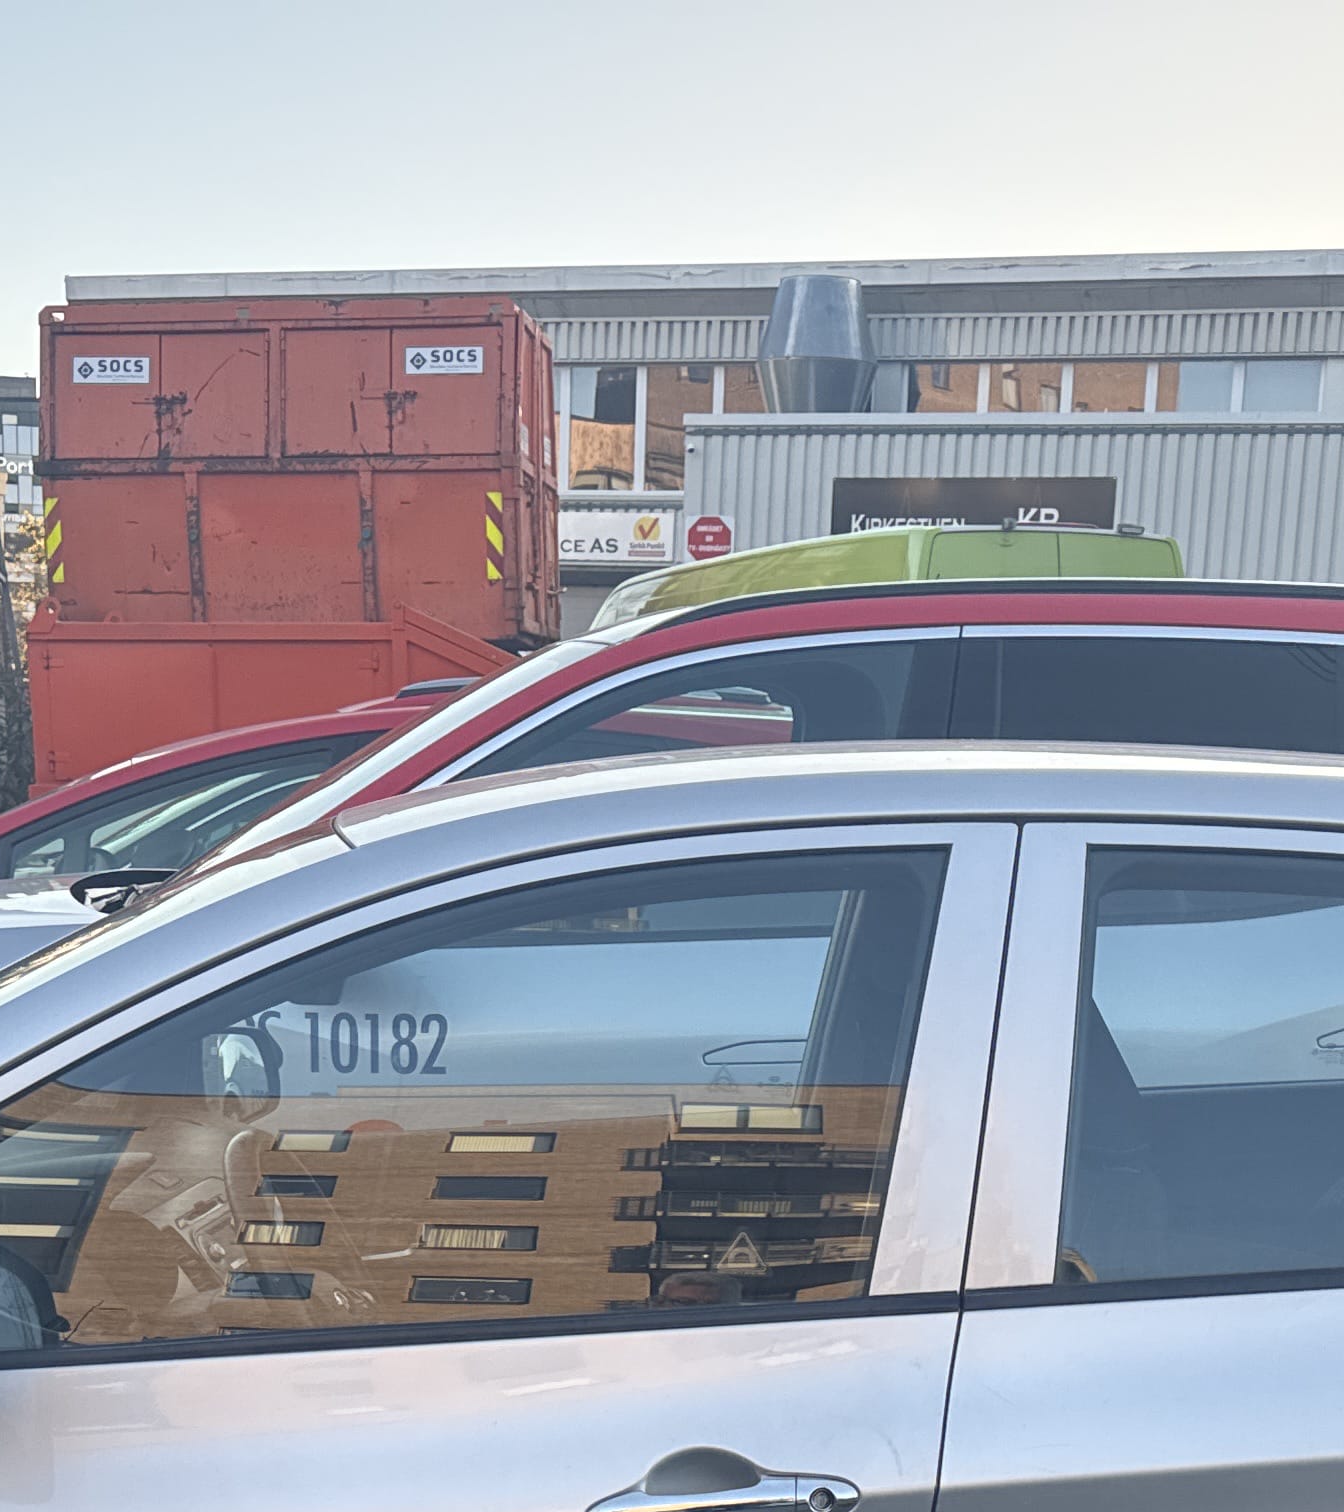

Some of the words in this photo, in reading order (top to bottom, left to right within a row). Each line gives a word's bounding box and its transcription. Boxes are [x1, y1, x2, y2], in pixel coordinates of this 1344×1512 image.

[430, 349, 477, 363] SOCS
[98, 359, 144, 373] SOCS
[560, 539, 586, 553] CE
[589, 538, 619, 553] AS
[305, 1011, 448, 1075] 10182
